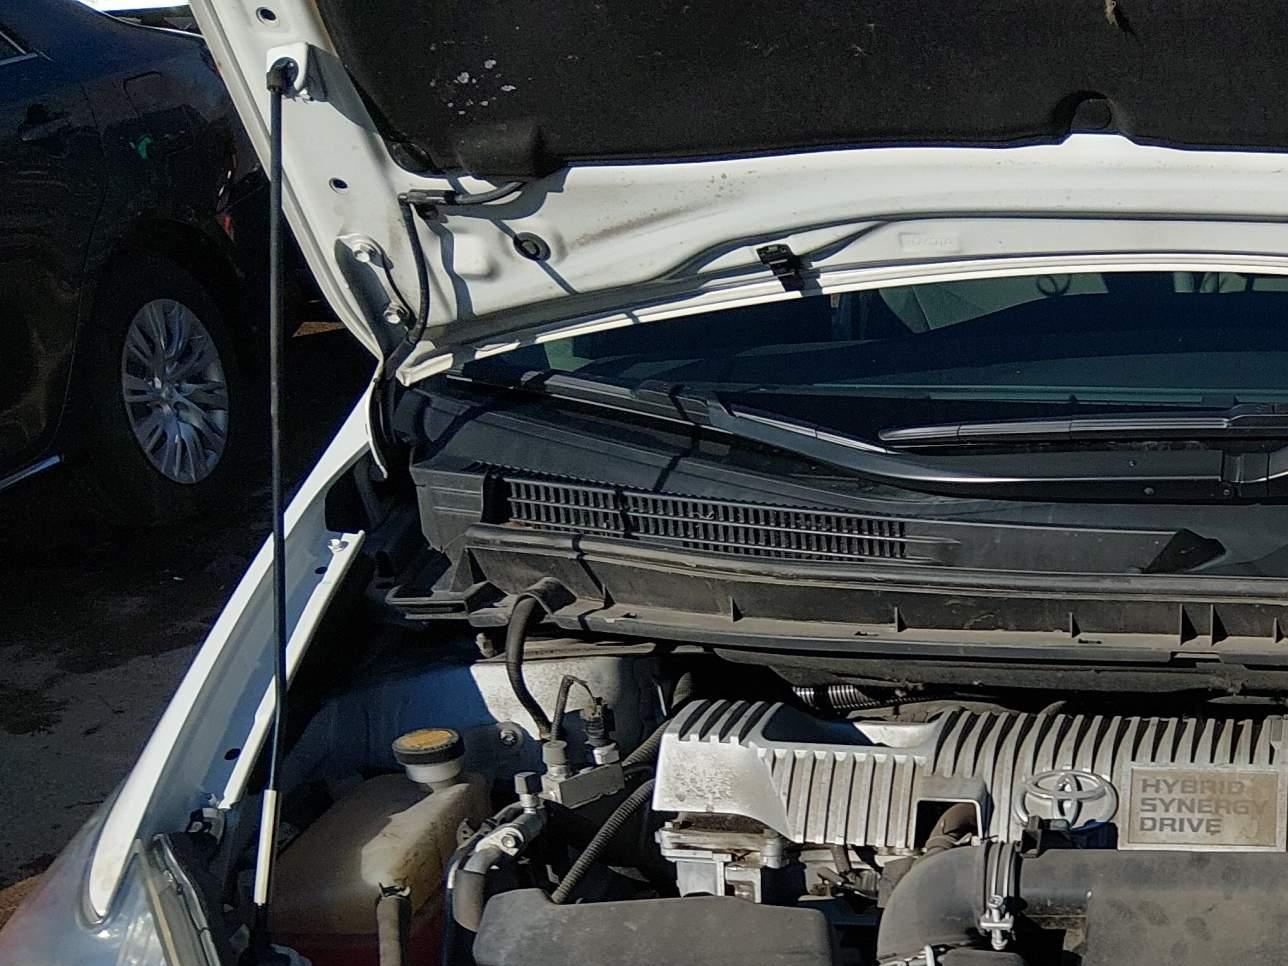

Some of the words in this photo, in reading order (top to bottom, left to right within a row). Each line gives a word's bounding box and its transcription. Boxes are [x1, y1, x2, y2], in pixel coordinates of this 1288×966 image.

[1141, 778, 1245, 794] HYBRID
[1140, 797, 1268, 815] SYNERGY
[1139, 816, 1223, 834] DRIVE
